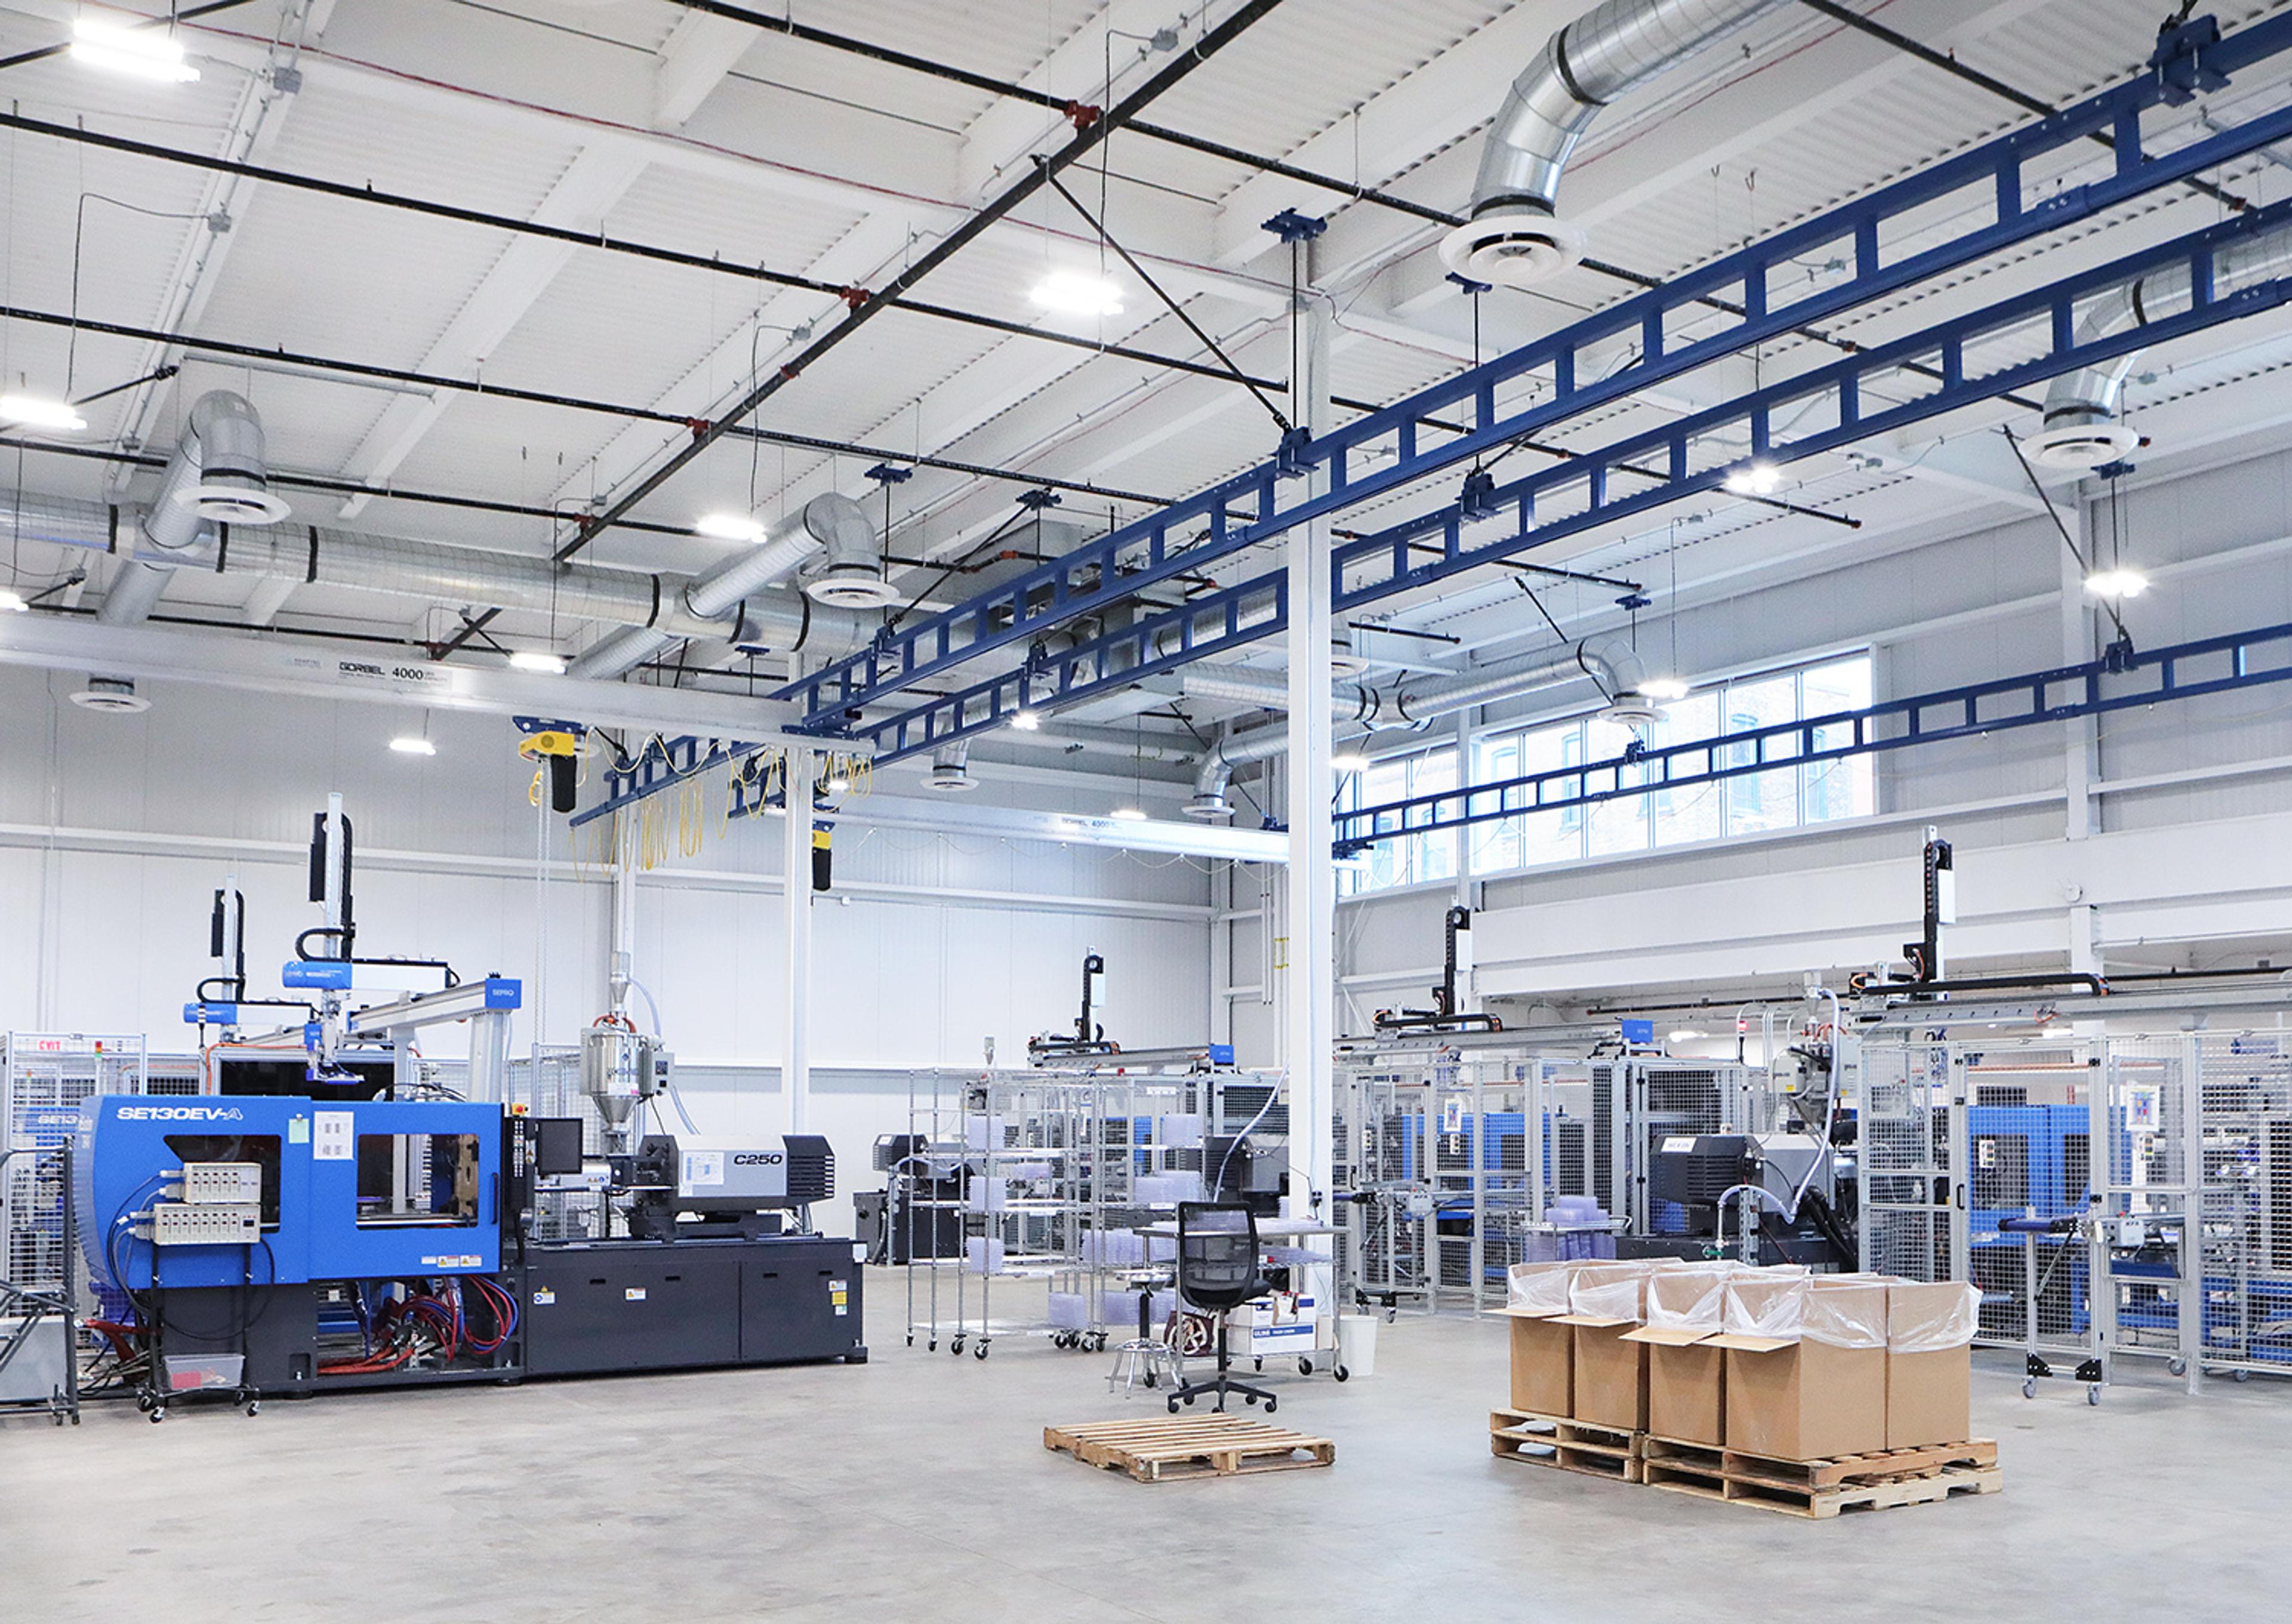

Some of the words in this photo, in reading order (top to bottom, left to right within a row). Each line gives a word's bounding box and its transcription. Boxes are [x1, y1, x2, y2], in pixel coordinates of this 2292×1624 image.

[339, 662, 385, 675] GORBEL
[392, 667, 424, 680] 4000
[116, 1107, 244, 1120] SE130EV-A
[734, 1154, 783, 1165] C250
